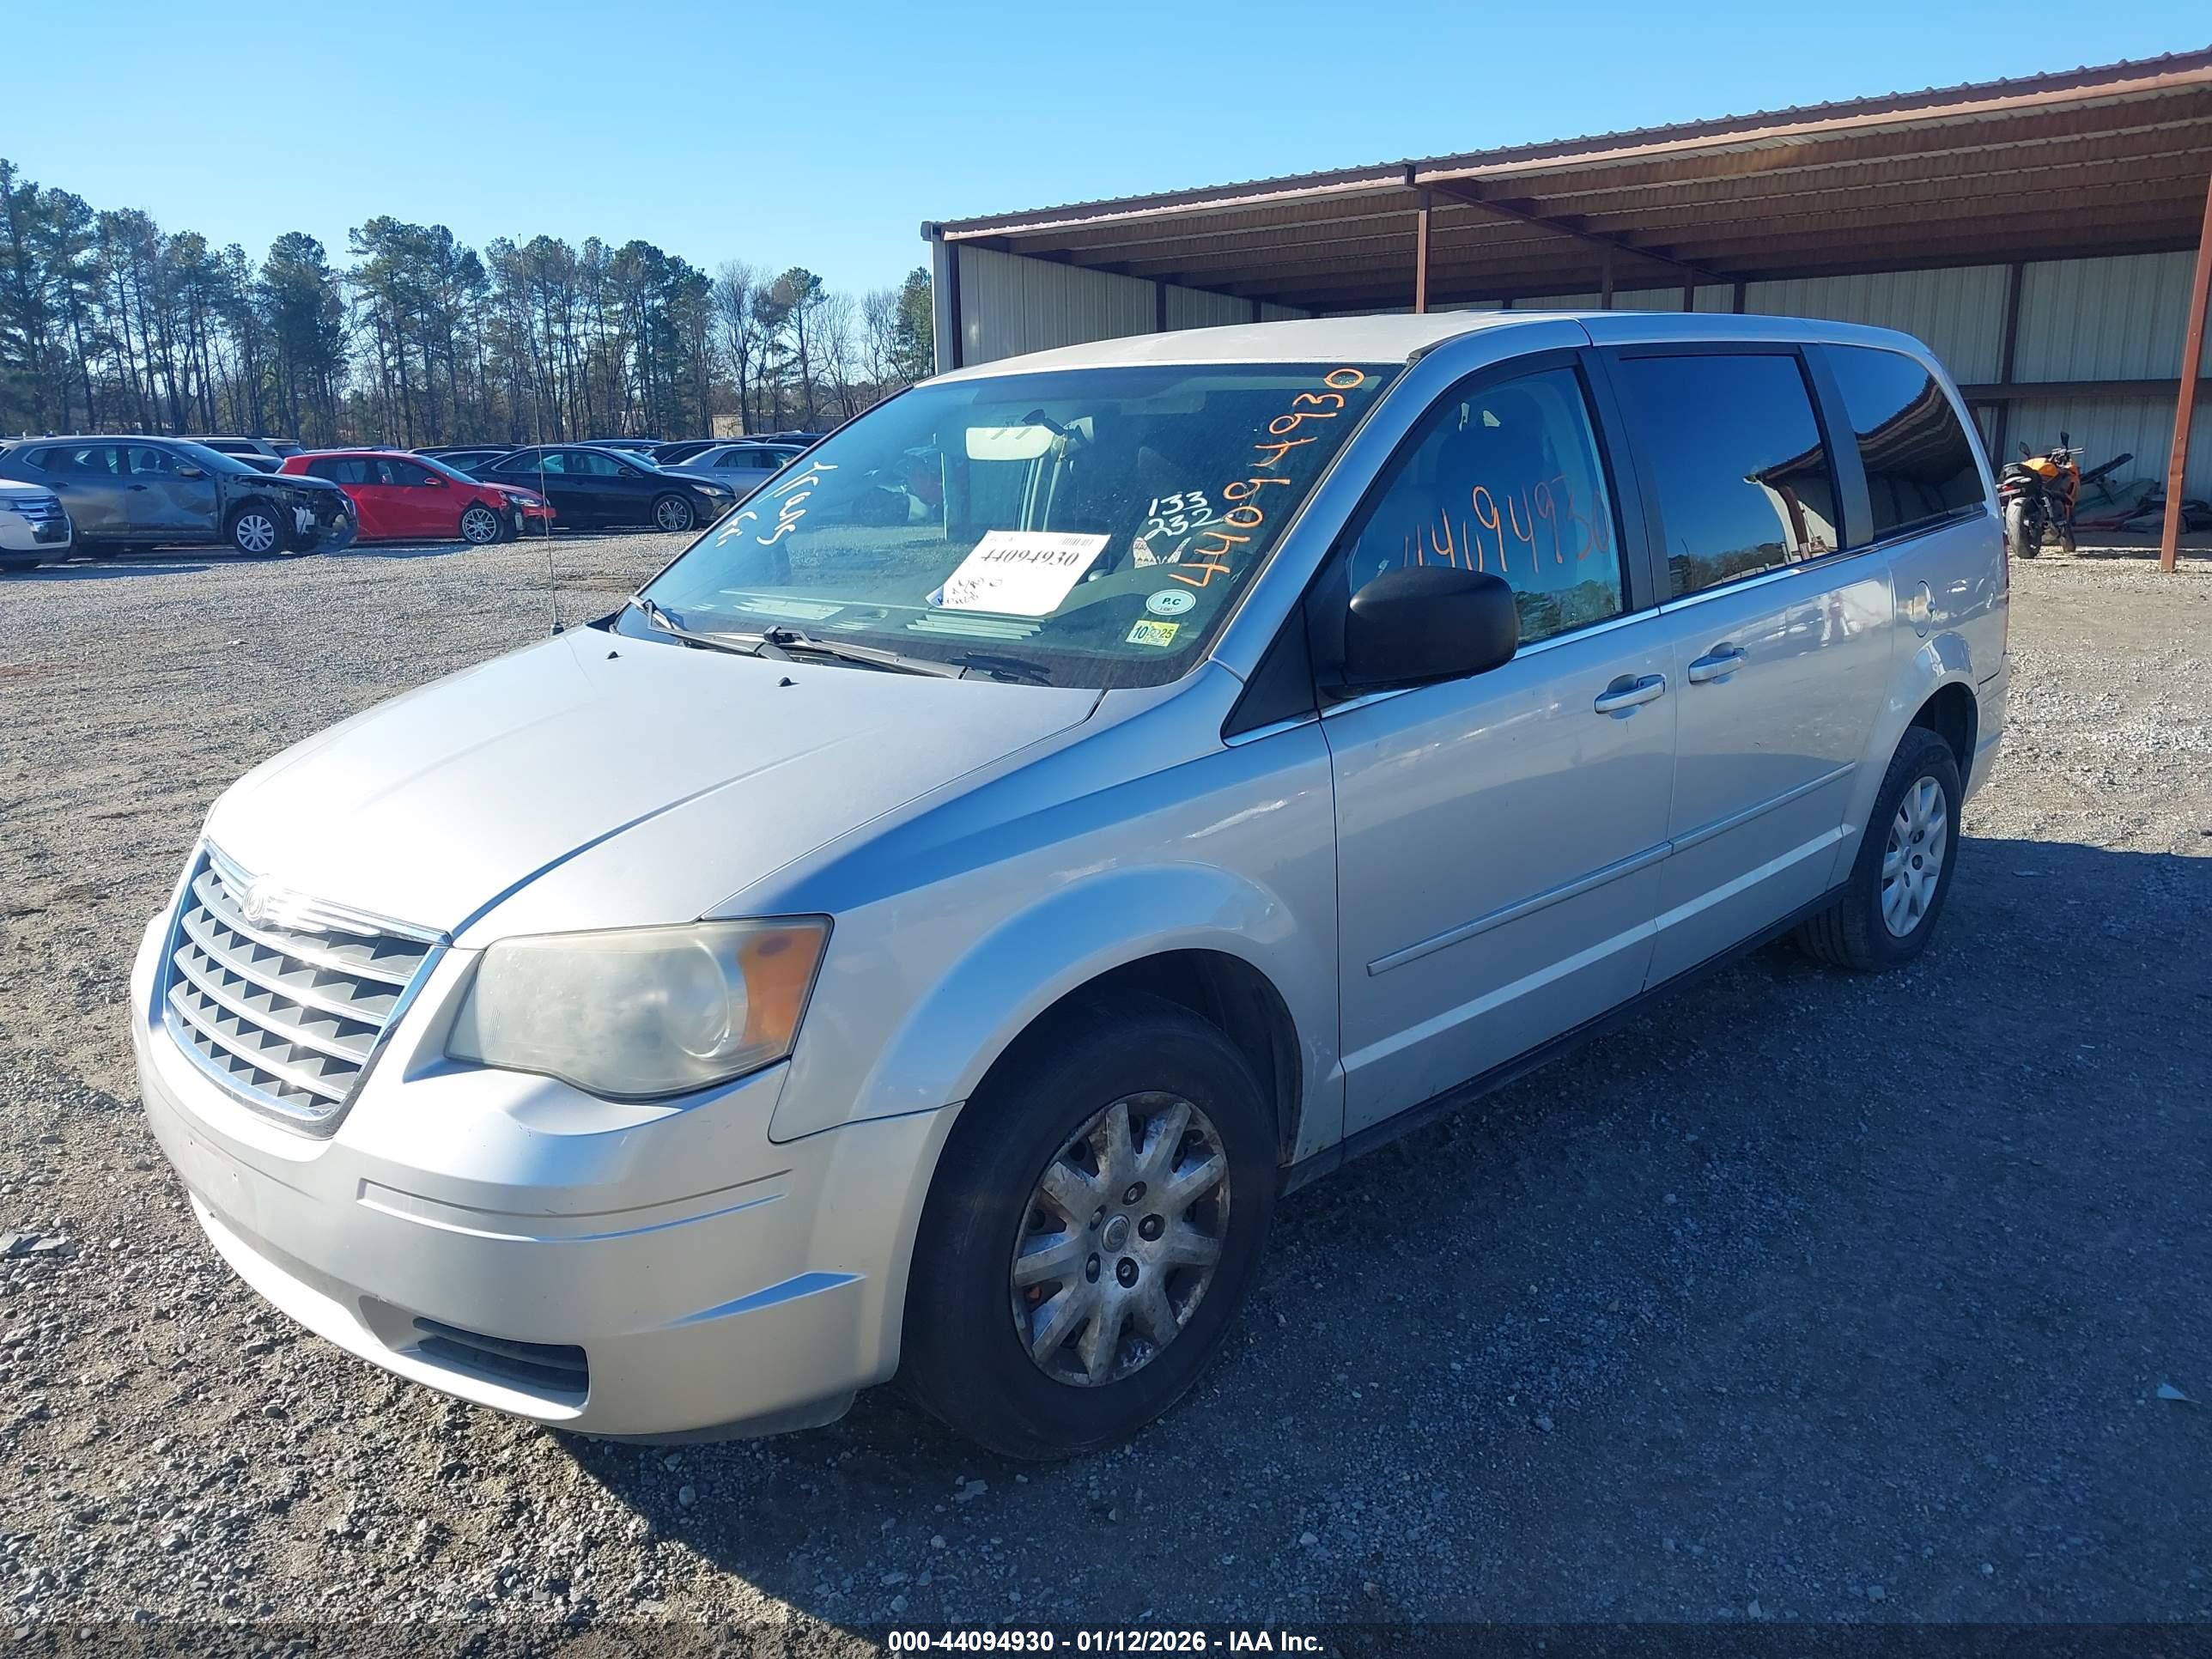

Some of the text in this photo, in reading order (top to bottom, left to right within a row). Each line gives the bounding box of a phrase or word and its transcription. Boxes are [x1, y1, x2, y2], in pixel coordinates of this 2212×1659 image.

[1168, 368, 1365, 587] 44094930
[1148, 490, 1208, 517] 133
[1144, 507, 1223, 541] 232
[981, 549, 1079, 567] 44094930
[1133, 625, 1175, 640] 10 25
